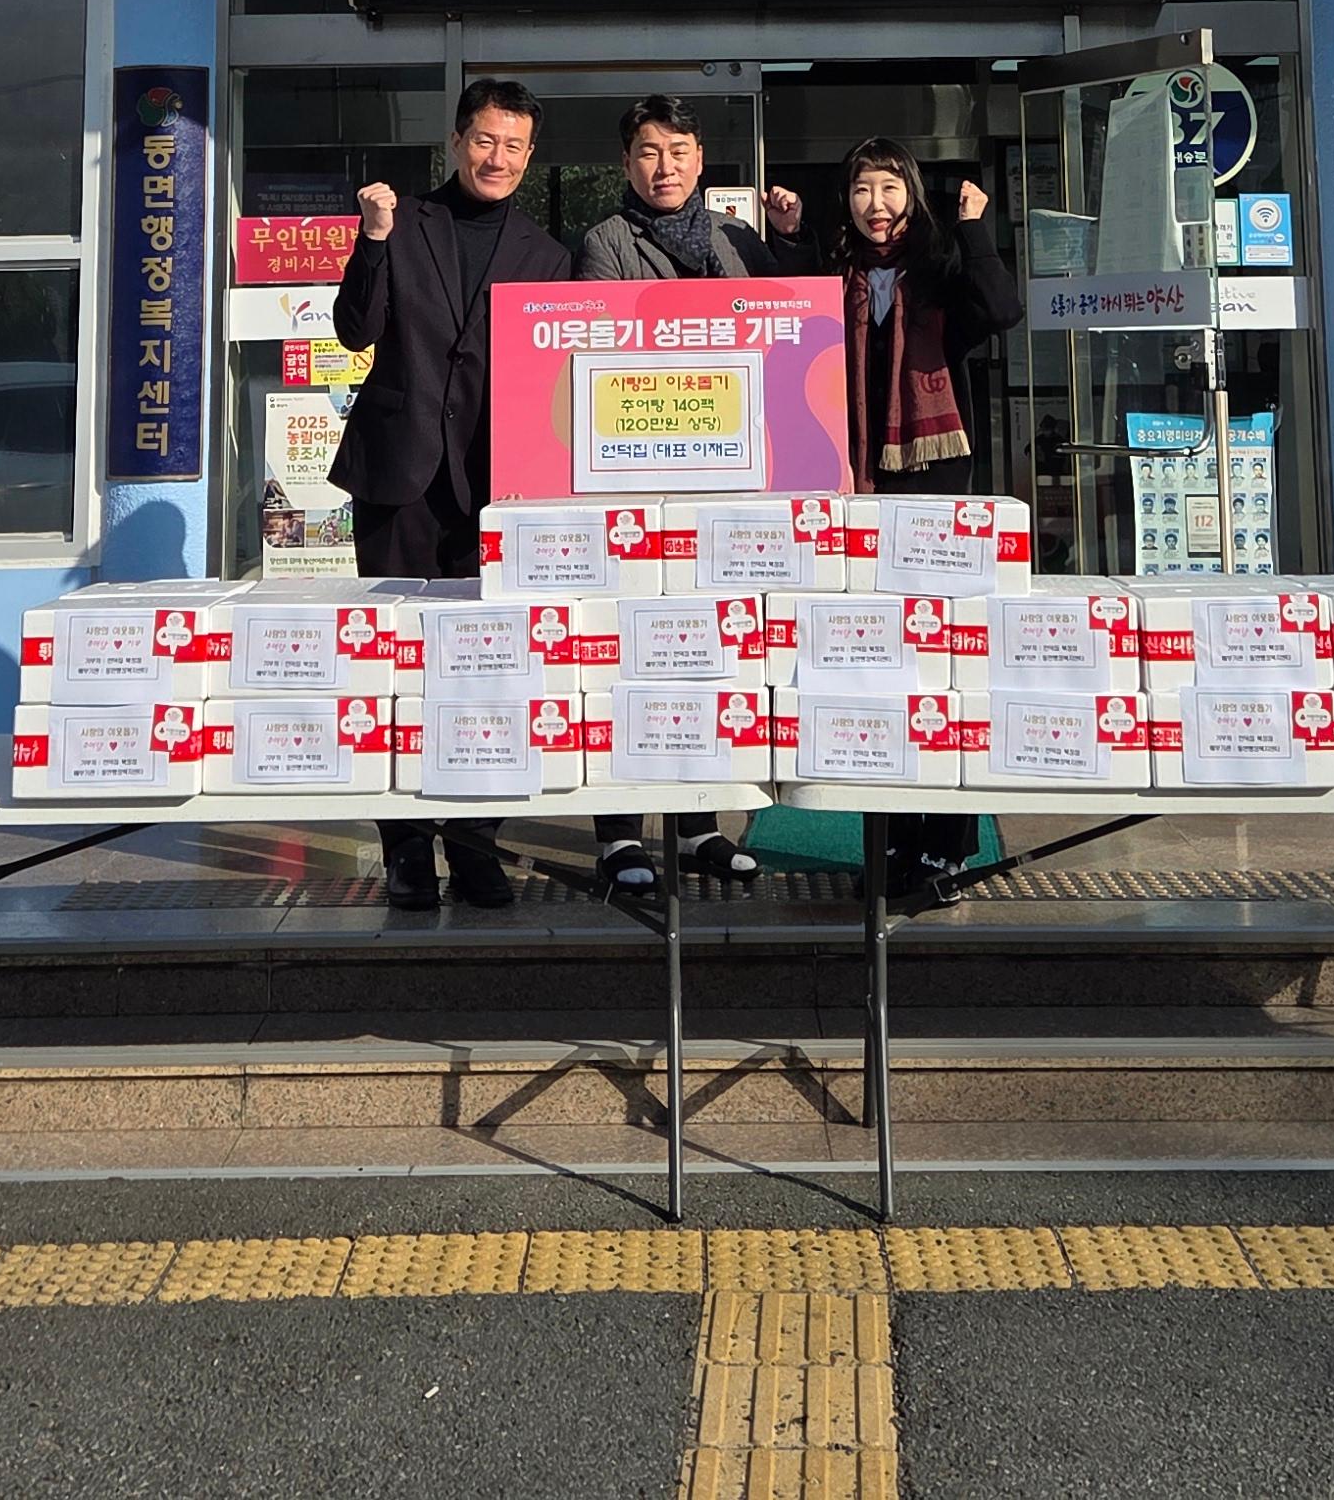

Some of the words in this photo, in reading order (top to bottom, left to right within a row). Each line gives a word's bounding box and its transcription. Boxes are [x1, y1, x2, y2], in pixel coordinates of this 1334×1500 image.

[136, 134, 176, 457] 동면행정복지센터
[1147, 284, 1184, 314] 양산
[1220, 286, 1257, 299] tive
[277, 292, 332, 333] Yan
[533, 320, 643, 349] 이웃돕기
[653, 317, 736, 346] 성금품
[745, 316, 802, 345] 기탁
[286, 353, 307, 367] 금연
[286, 367, 307, 380] 구역
[610, 376, 657, 392] 사랑의
[667, 375, 728, 392] 이웃돕기
[621, 398, 664, 413] 추어탕
[673, 398, 715, 413] 140팩
[287, 416, 328, 429] 2025
[615, 417, 679, 432] (120만원
[688, 416, 721, 432] 상당)
[286, 430, 341, 445] 농림어업
[600, 444, 647, 459] 언덕집
[652, 443, 687, 459] (대표
[693, 442, 744, 458] 이재근)
[938, 519, 952, 528] 이웃
[1195, 515, 1213, 527] 112
